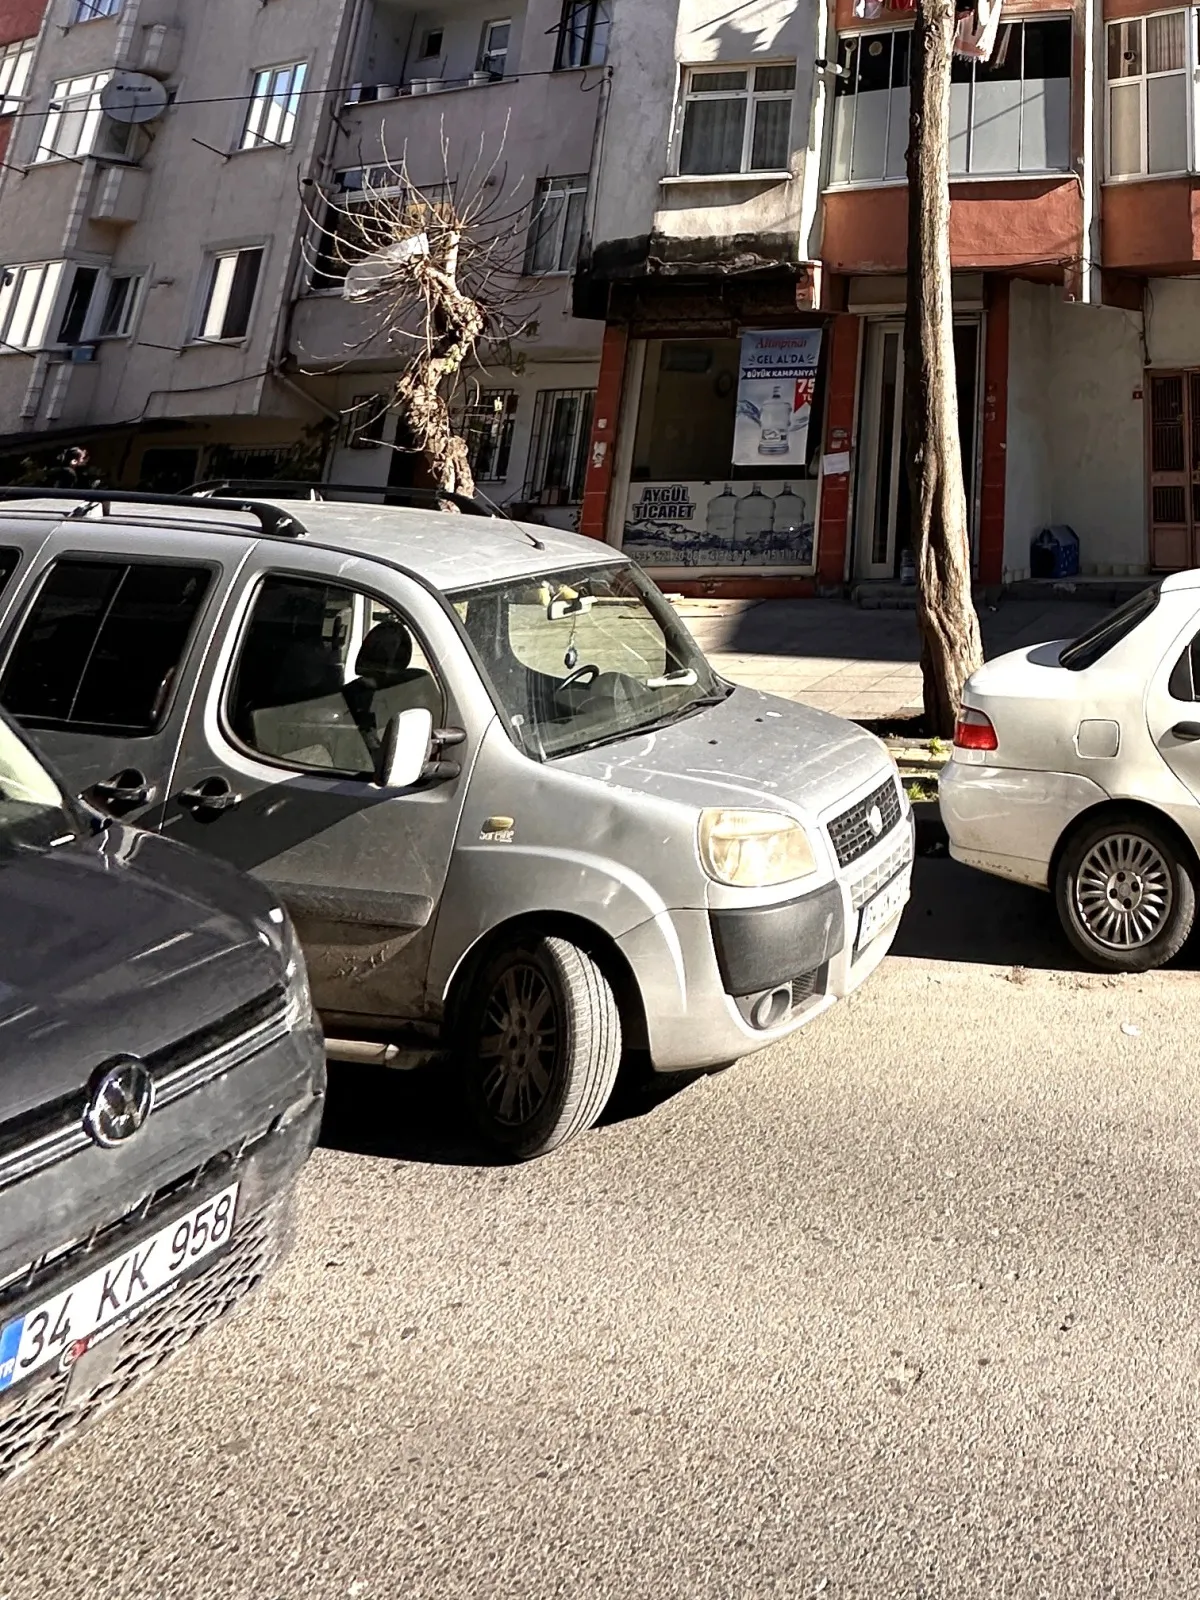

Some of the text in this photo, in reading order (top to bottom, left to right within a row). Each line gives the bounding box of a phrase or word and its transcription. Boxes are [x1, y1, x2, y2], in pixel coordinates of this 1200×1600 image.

[756, 354, 773, 365] GEL
[746, 368, 771, 378] BÜYÜK
[797, 378, 816, 393] 75
[642, 485, 689, 502] AYGÜL
[634, 502, 695, 519] TİCARET
[20, 1292, 74, 1369] 34
[95, 1240, 158, 1323] KK
[169, 1194, 232, 1272] 958
